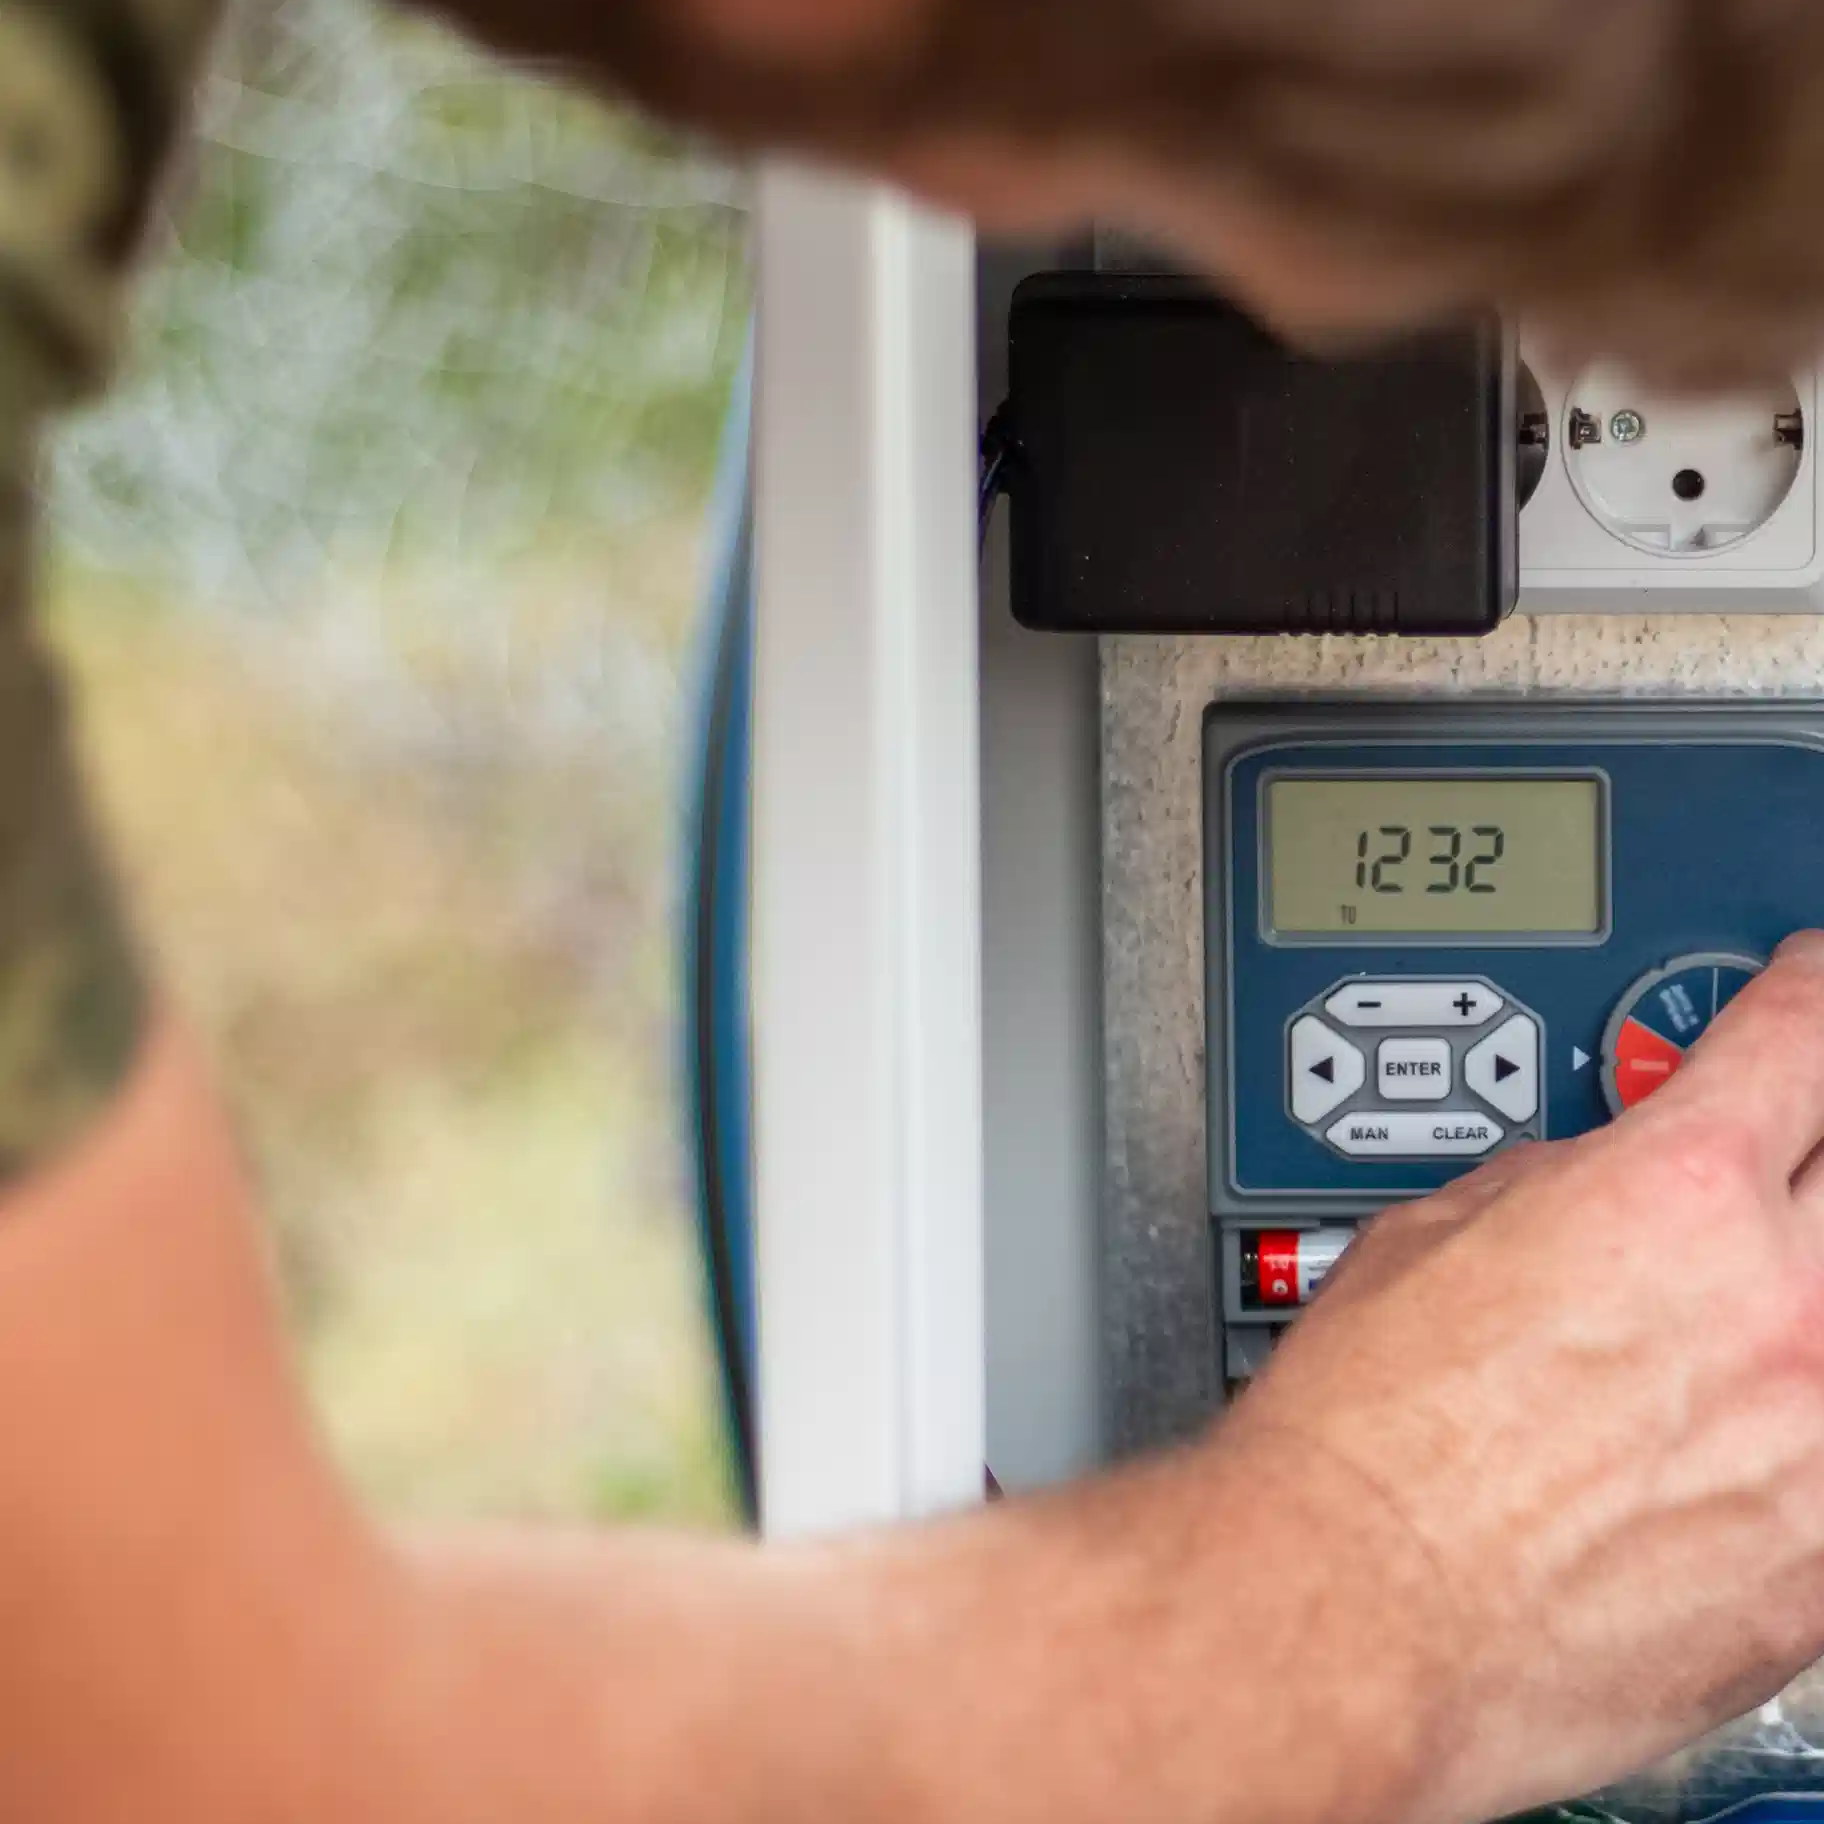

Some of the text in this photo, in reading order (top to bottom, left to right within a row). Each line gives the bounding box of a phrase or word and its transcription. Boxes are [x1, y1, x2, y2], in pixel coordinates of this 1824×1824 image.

[1386, 1062, 1441, 1076] ENTER
[1350, 1127, 1489, 1140] MAN CLEAR
